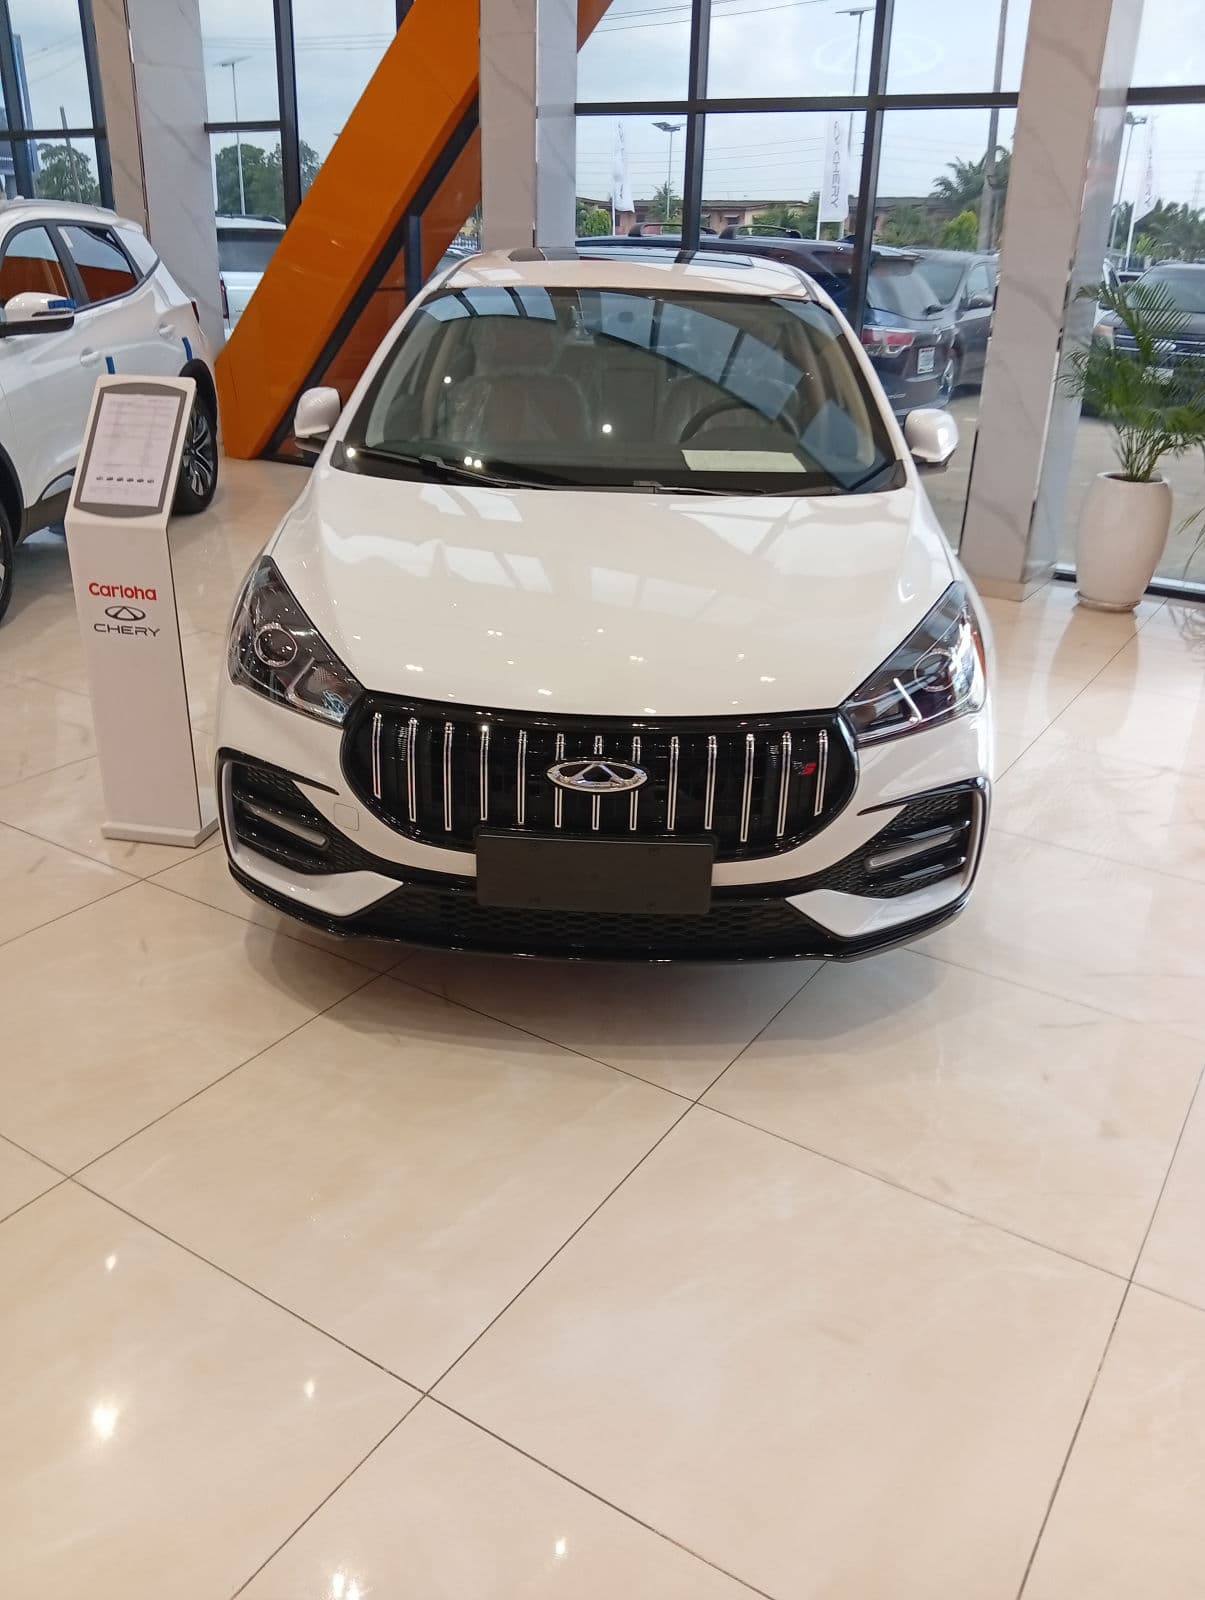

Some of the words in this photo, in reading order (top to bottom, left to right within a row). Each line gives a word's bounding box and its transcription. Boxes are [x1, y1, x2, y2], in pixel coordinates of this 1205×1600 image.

[830, 150, 841, 208] CHERY
[89, 582, 157, 601] Carloha
[94, 623, 161, 637] CHERY
